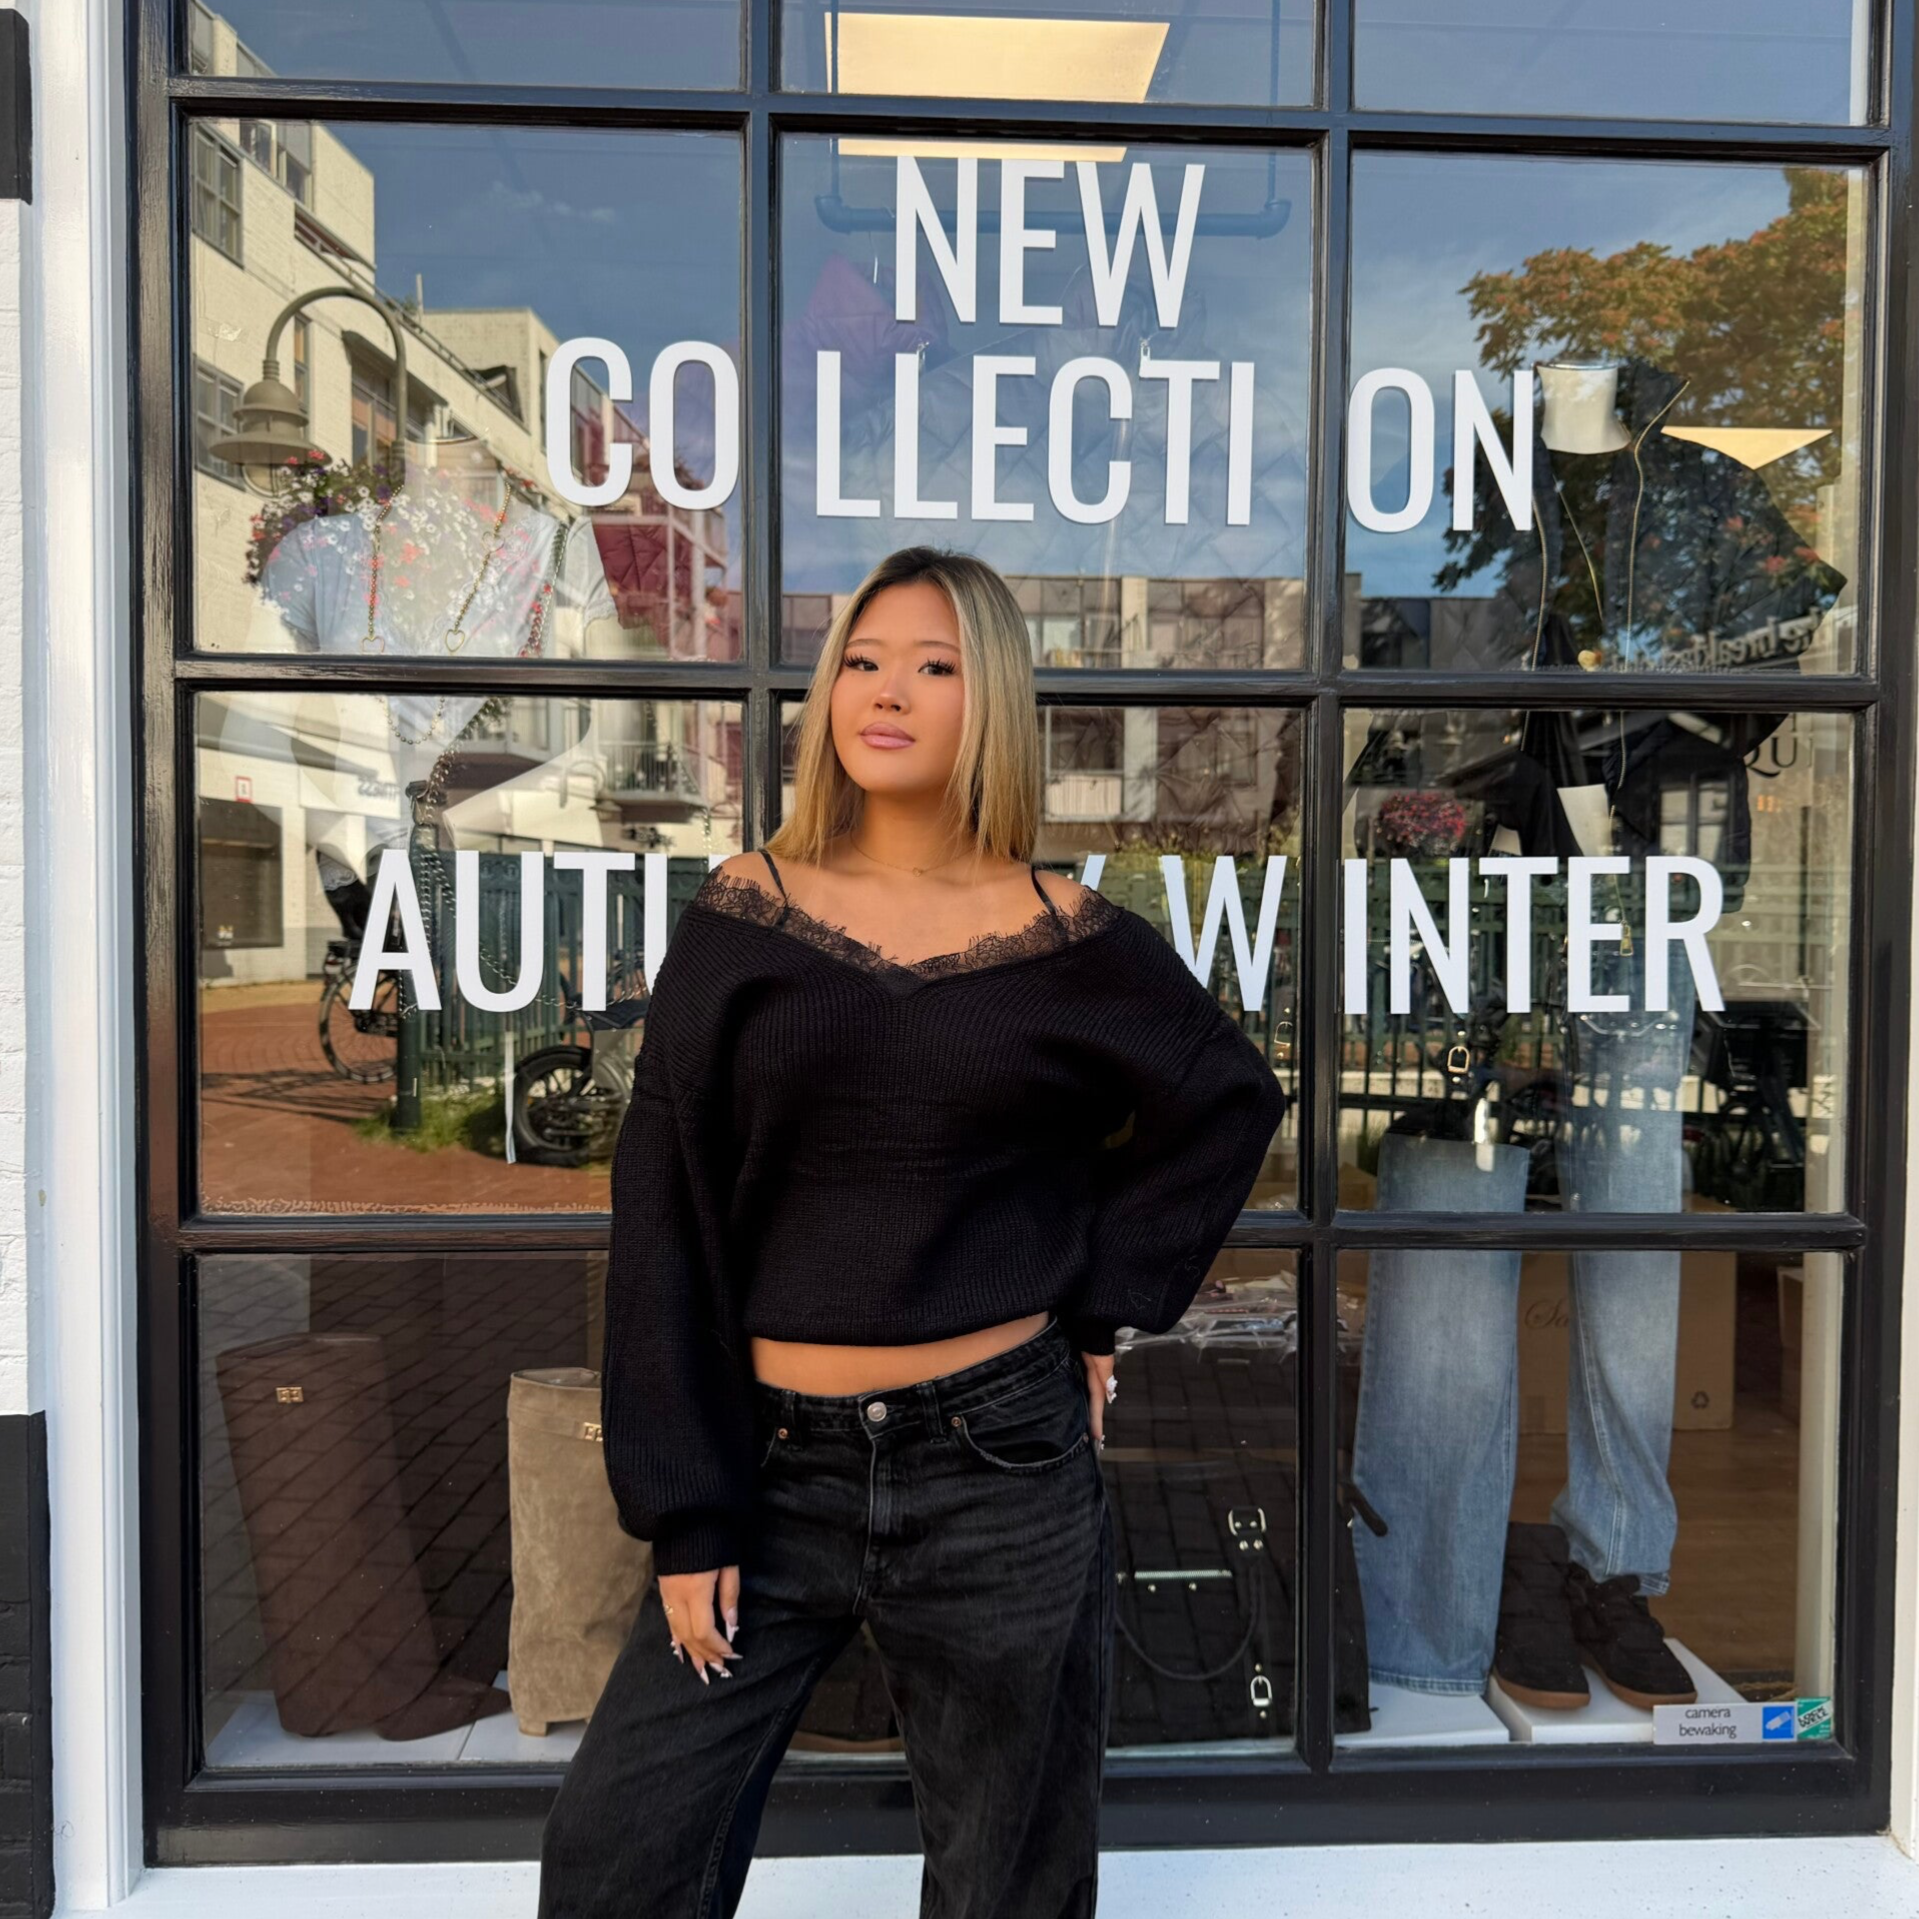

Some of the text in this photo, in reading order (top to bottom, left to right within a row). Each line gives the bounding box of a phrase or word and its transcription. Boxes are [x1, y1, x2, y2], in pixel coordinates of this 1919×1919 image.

[895, 153, 1206, 328] NEW
[1161, 855, 1726, 1016] WINTER
[1679, 1722, 1737, 1739] bewaking
[1685, 1706, 1731, 1719] camera
